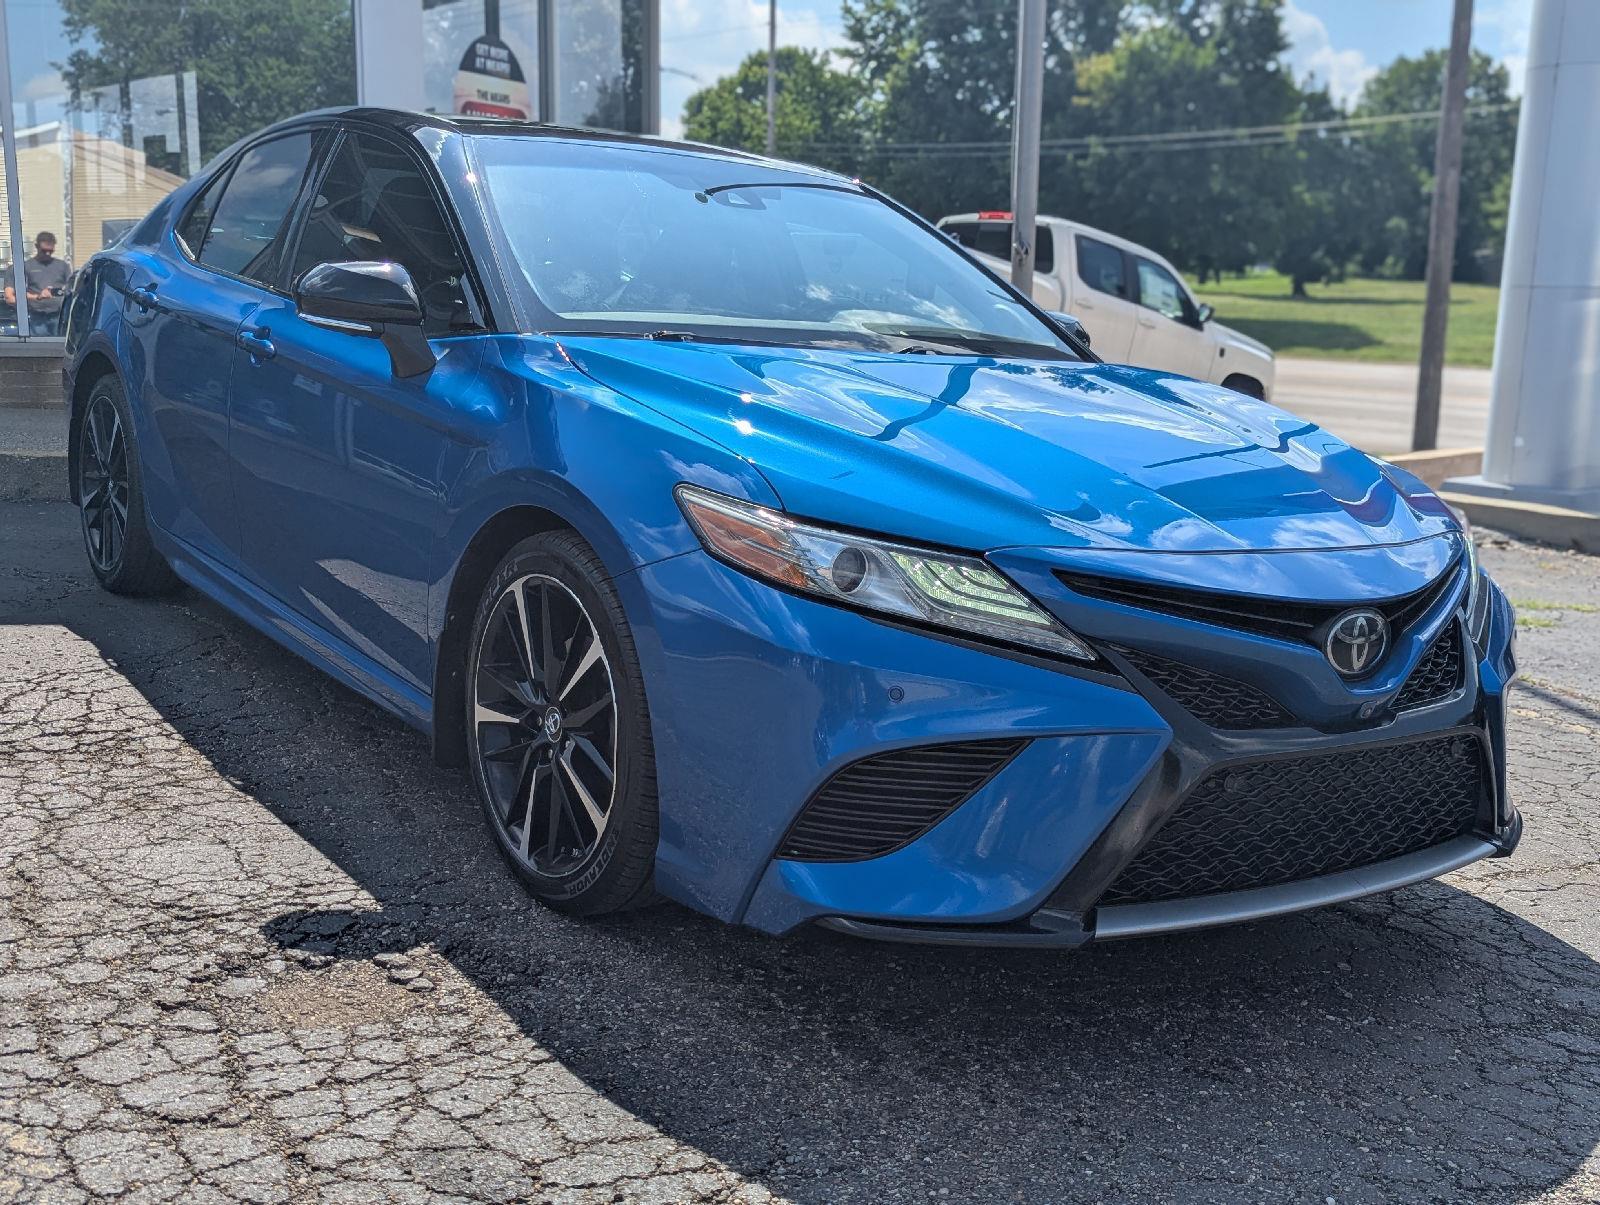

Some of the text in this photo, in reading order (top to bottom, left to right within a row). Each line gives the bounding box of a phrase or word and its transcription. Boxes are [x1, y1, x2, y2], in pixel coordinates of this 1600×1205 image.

[475, 43, 489, 57] GET
[477, 89, 488, 101] THE
[568, 827, 620, 893] ENDEAVOR
